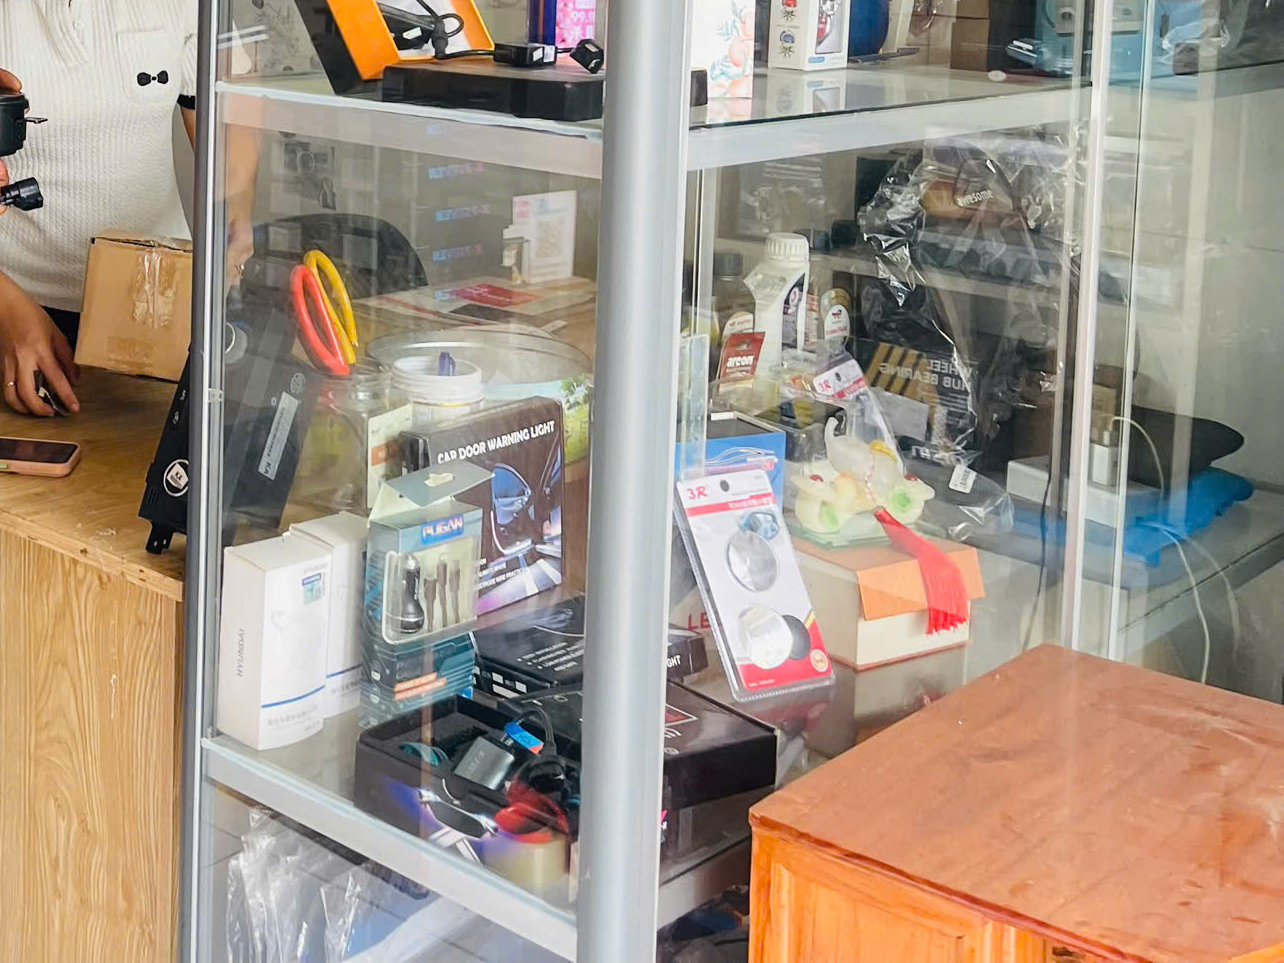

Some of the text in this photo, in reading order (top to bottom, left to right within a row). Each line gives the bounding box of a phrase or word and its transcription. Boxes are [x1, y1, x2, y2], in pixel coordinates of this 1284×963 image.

[727, 354, 754, 367] areon
[437, 420, 555, 464] CAR DOOR WARNING LIGHT
[686, 485, 708, 500] 3R
[236, 628, 245, 678] HYUNDAI
